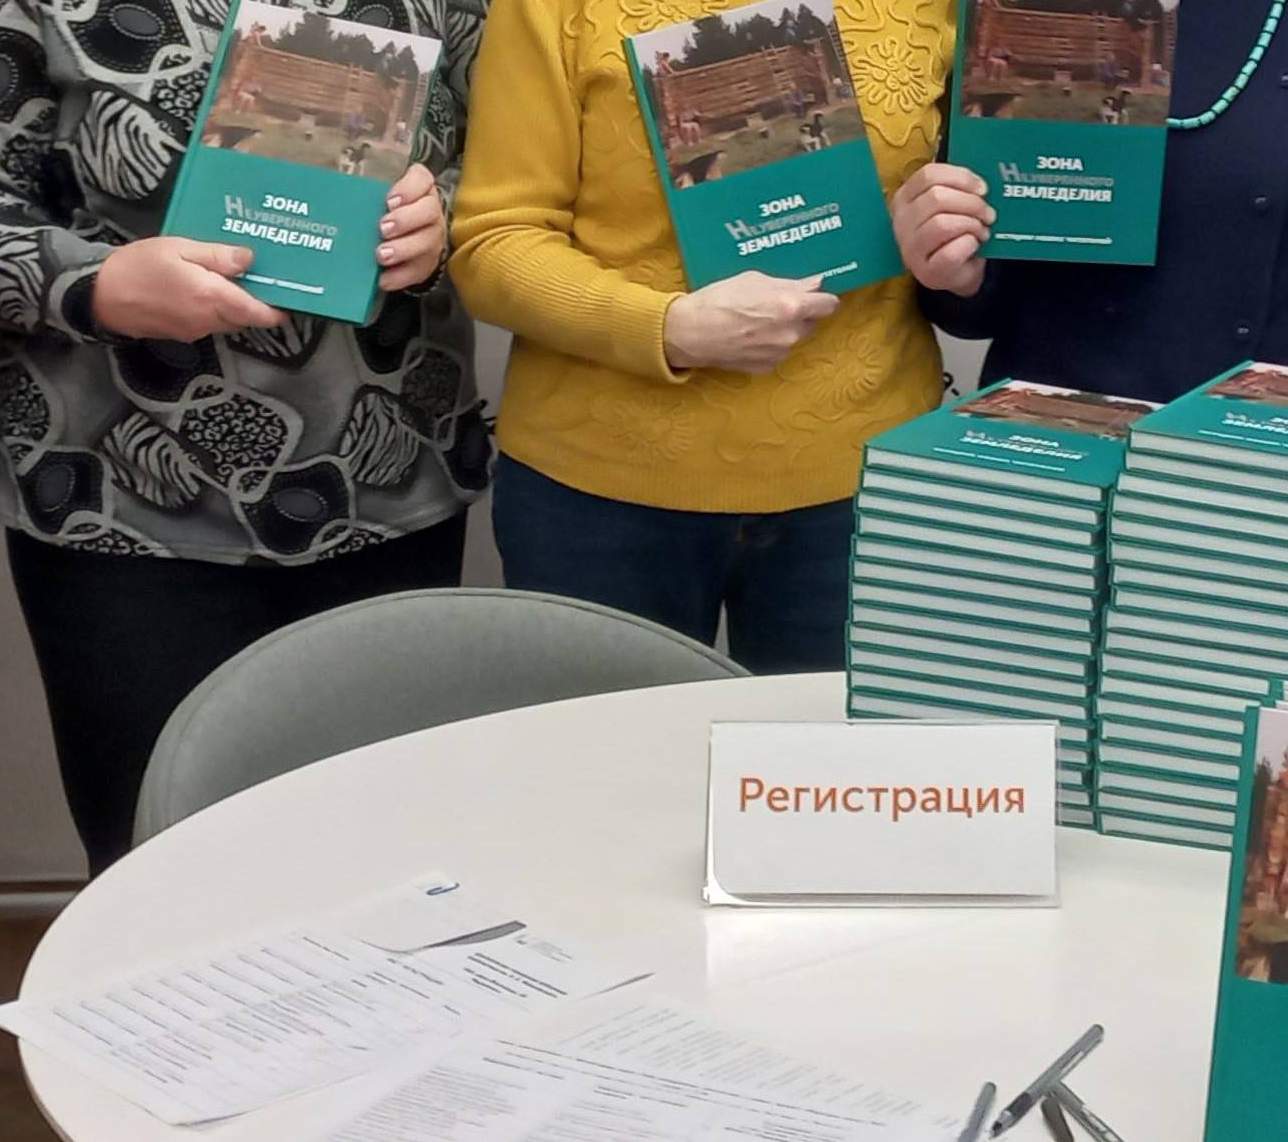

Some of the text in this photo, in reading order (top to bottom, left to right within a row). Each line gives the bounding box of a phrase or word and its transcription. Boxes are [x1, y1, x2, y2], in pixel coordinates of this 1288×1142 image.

[1036, 156, 1083, 171] ЗОНА
[262, 194, 309, 216] ЗОНА
[1003, 185, 1112, 202] ЗЕМЛЕДЕЛИЯ
[759, 194, 806, 217] ЗОНА
[222, 218, 333, 252] ЗЕМЛЕДЕЛИЯ
[737, 215, 842, 257] ЗЕМЛЕДЕЛИЯ
[739, 777, 1026, 822] Регистрация
